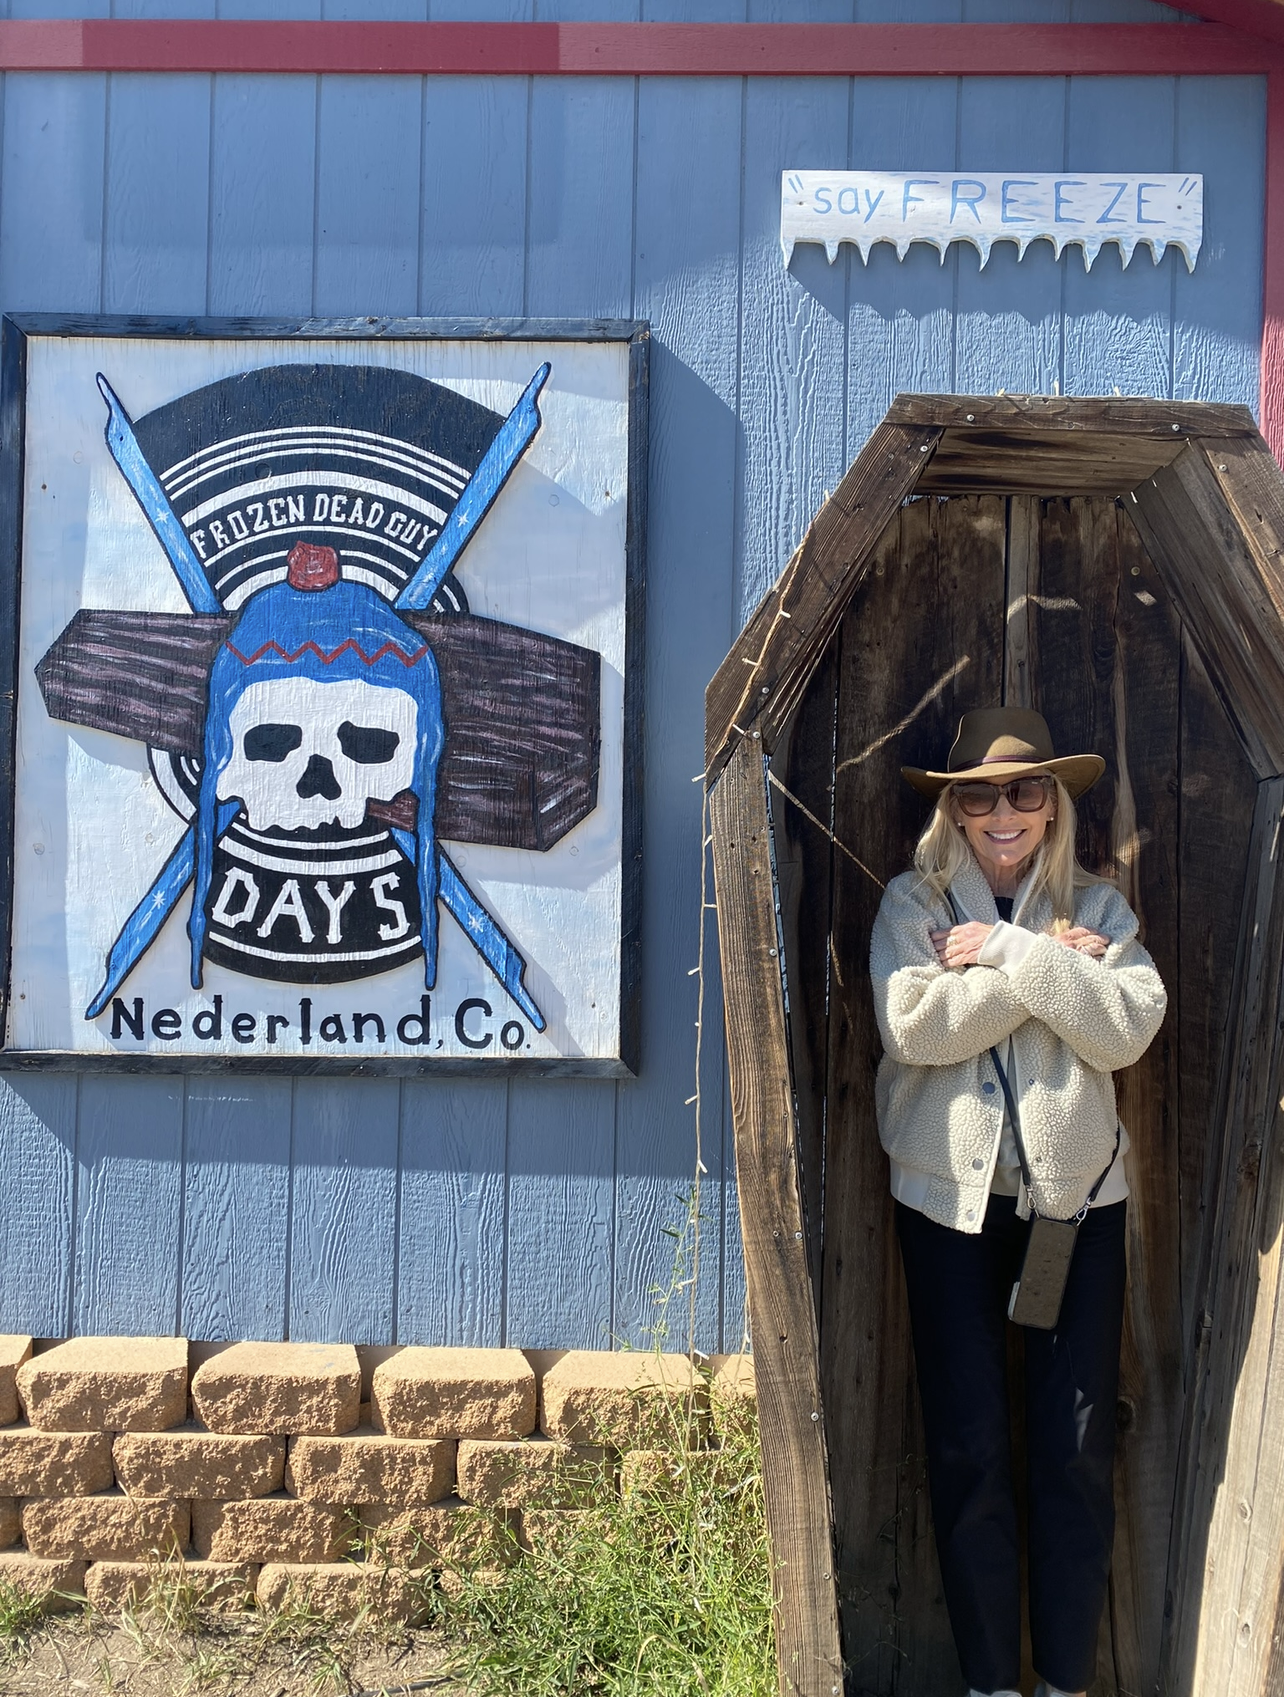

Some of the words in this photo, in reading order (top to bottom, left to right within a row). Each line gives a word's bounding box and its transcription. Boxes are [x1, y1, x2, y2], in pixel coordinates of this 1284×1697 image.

[189, 493, 306, 559] FROZEN
[312, 493, 386, 529] DEAD
[383, 511, 439, 551] GUY
[211, 866, 411, 945] DAYS
[109, 994, 444, 1050] Nederland,
[455, 997, 531, 1051] Co.
